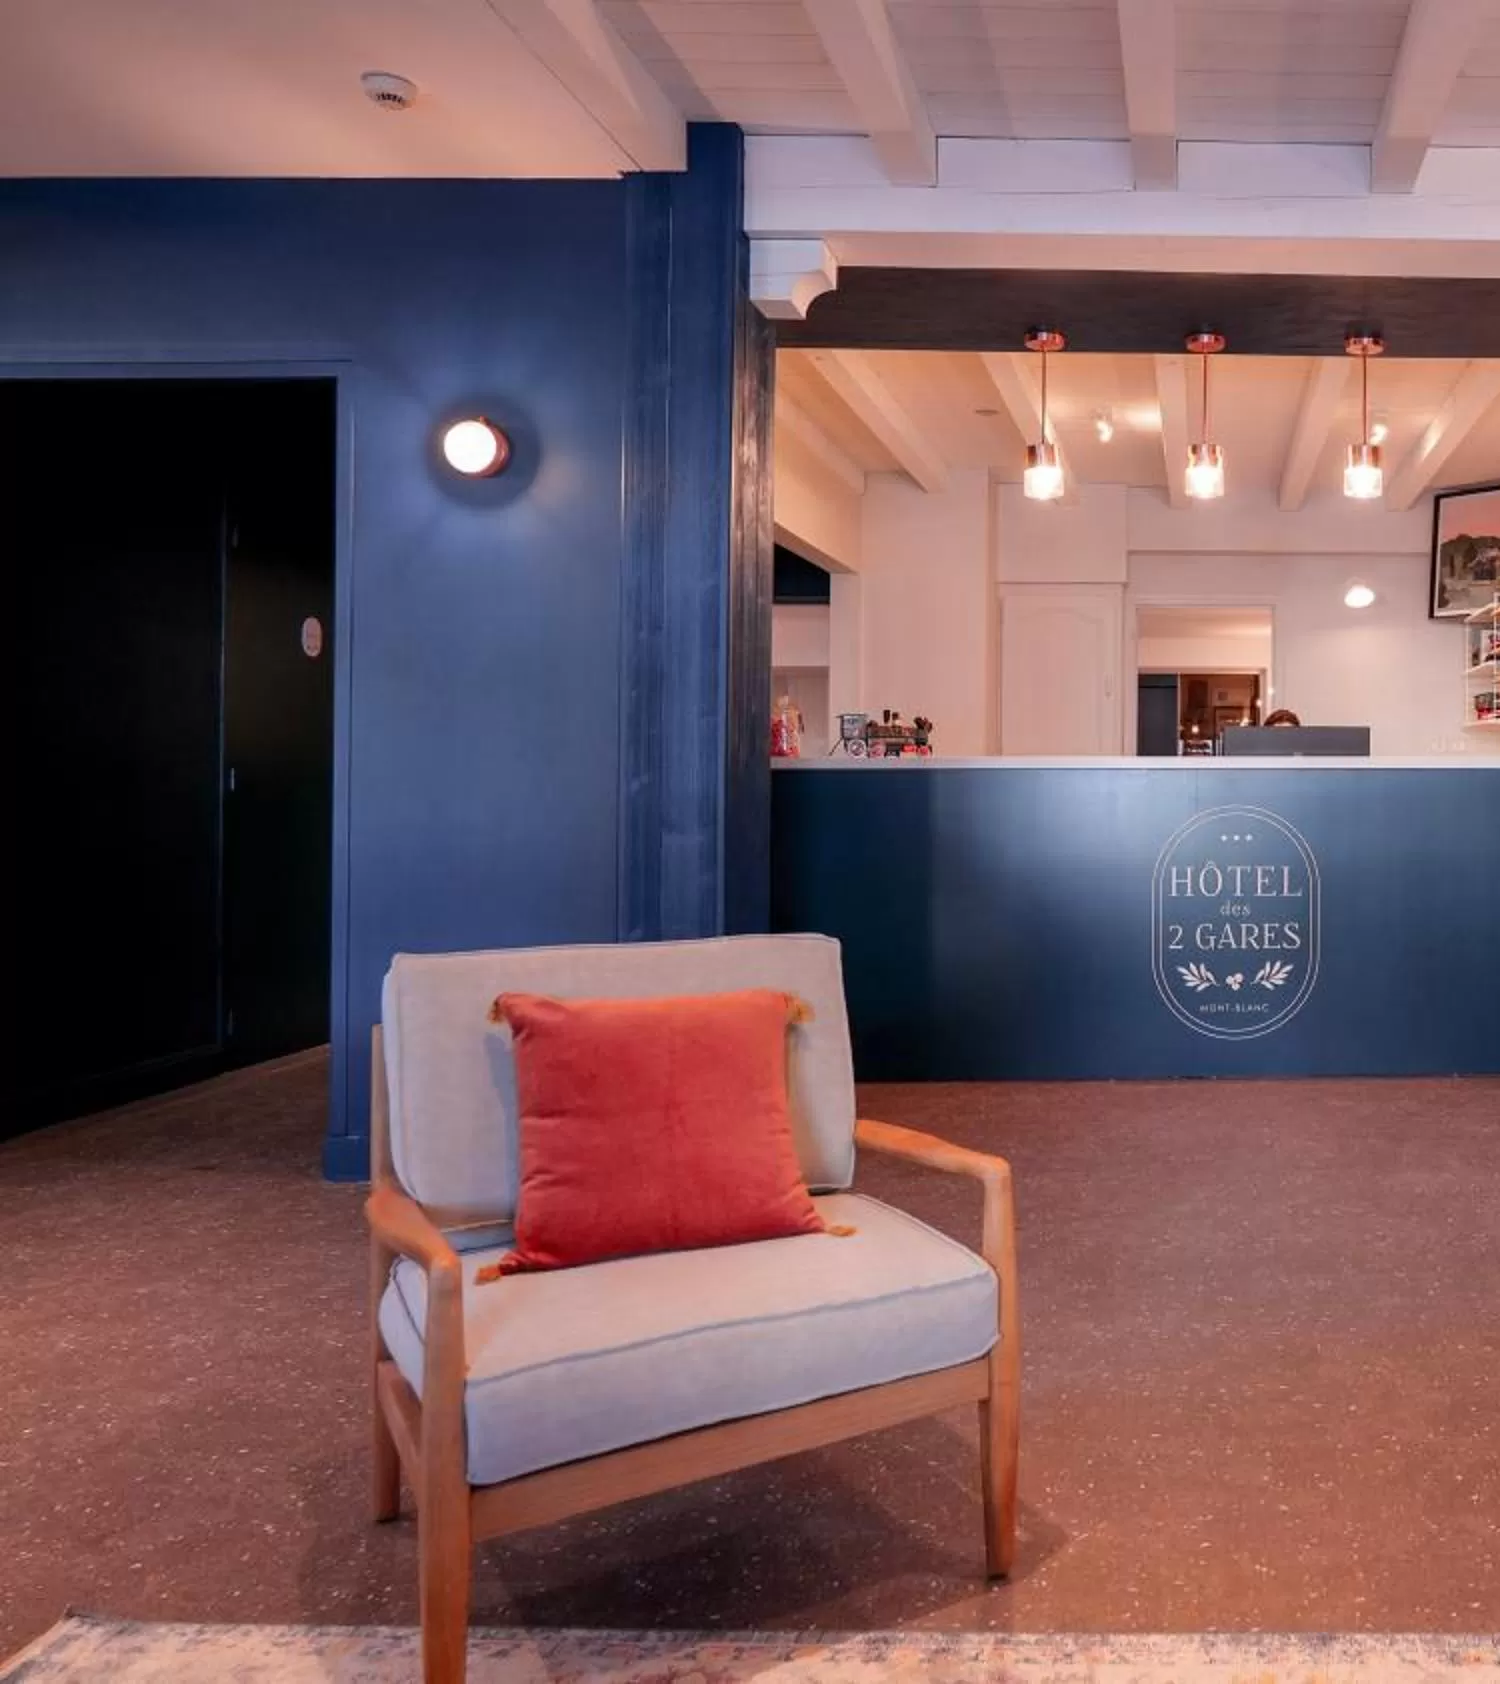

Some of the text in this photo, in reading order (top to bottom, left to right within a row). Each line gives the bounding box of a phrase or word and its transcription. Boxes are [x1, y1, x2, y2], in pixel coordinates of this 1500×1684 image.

[1168, 860, 1302, 897] HÔTEL
[1220, 899, 1251, 916] des
[1168, 922, 1301, 951] 2 GARES
[1199, 1002, 1269, 1013] MONT-BLANC
